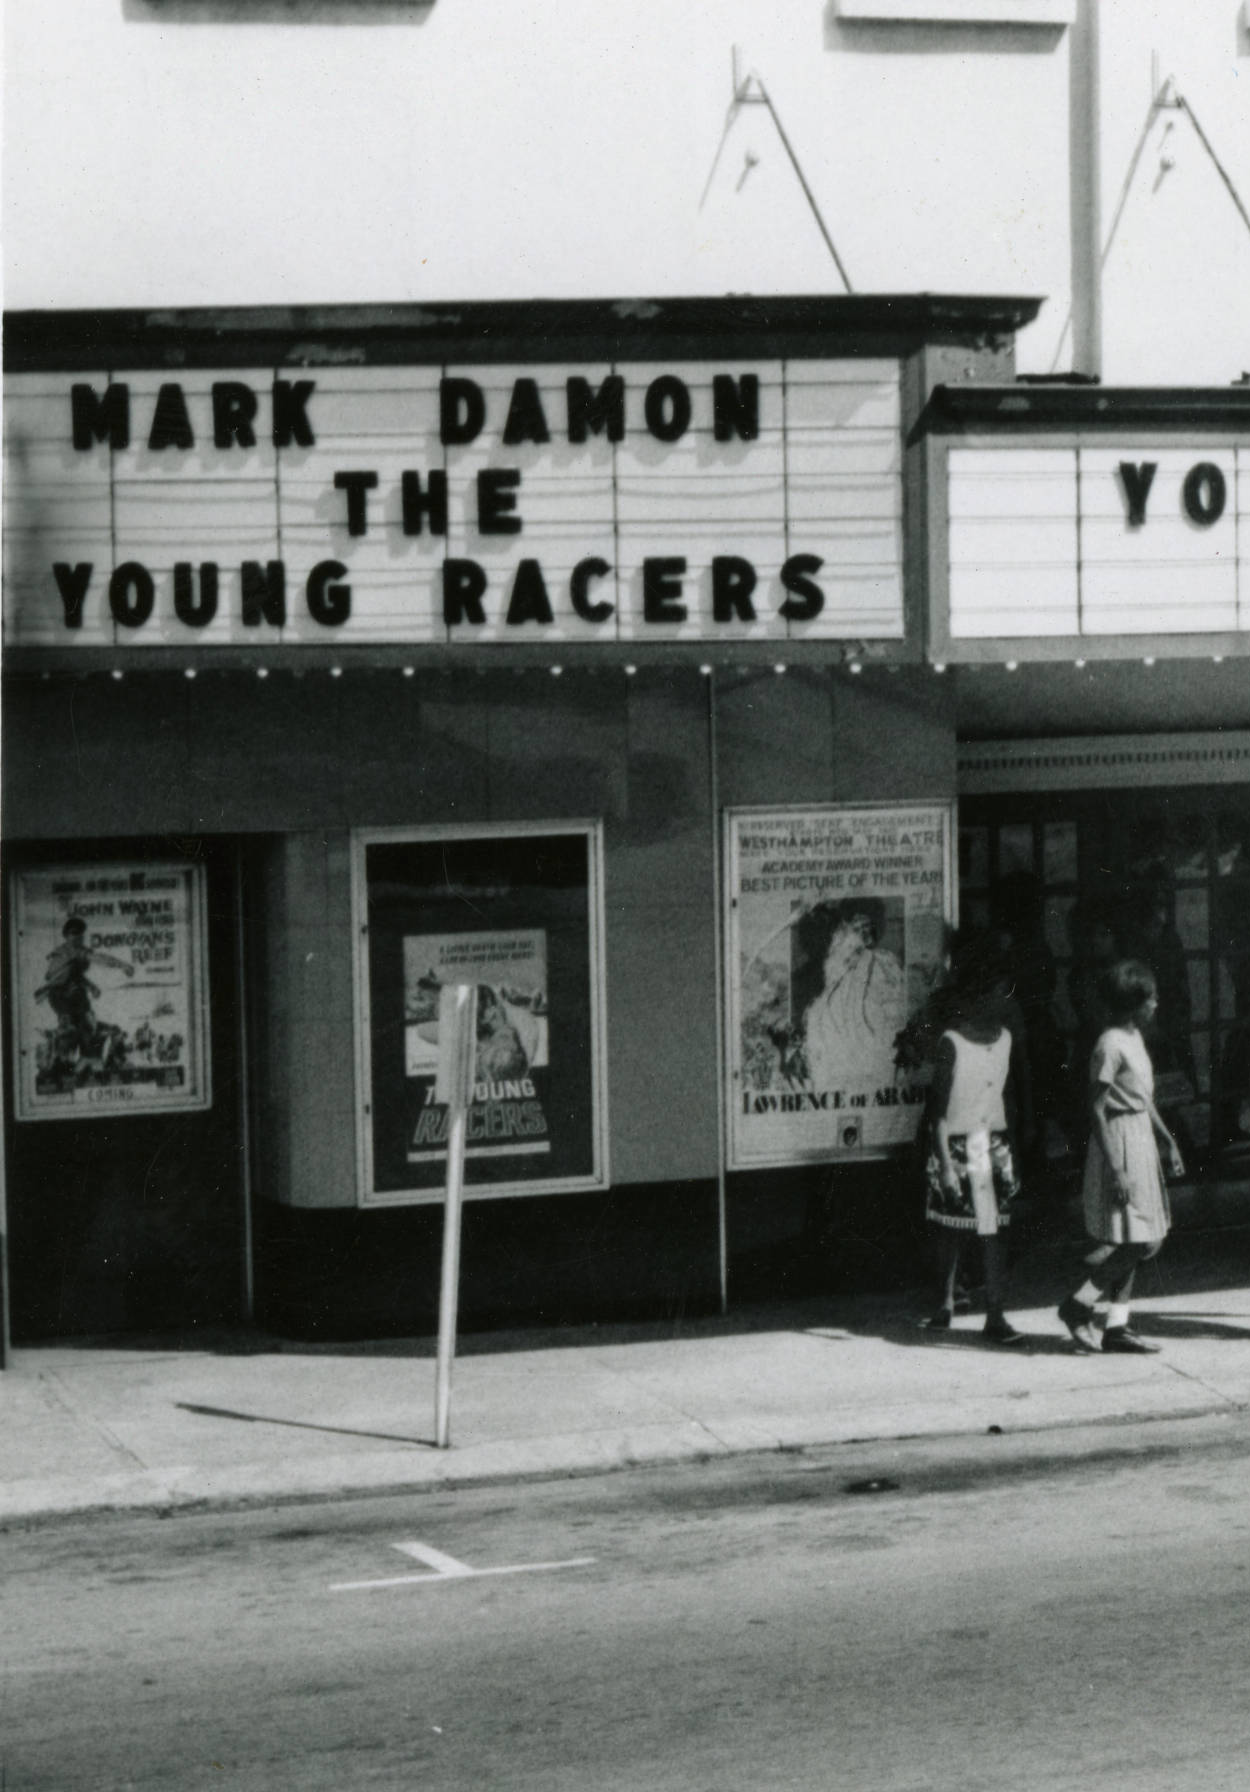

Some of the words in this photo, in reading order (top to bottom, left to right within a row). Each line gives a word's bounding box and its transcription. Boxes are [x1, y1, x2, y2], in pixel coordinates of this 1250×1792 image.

[70, 380, 316, 450] MARK
[438, 373, 760, 447] DAMON
[334, 468, 523, 537] THE
[53, 560, 352, 627] YOUNG
[441, 554, 826, 626] RACERS
[739, 833, 854, 849] WESTHAMPTON
[866, 829, 943, 847] THEATRE
[761, 859, 824, 874] ACADEMY
[826, 857, 871, 872] AWARD
[873, 854, 924, 870] WINNER
[741, 876, 780, 892] BEST
[783, 873, 844, 890] PICTURE
[847, 872, 868, 887] OF
[871, 871, 900, 887] THE
[68, 902, 114, 918] JOHN
[119, 898, 173, 916] WAYNE
[474, 1078, 536, 1102] OUNG
[742, 1089, 845, 1115] LAWRENCE
